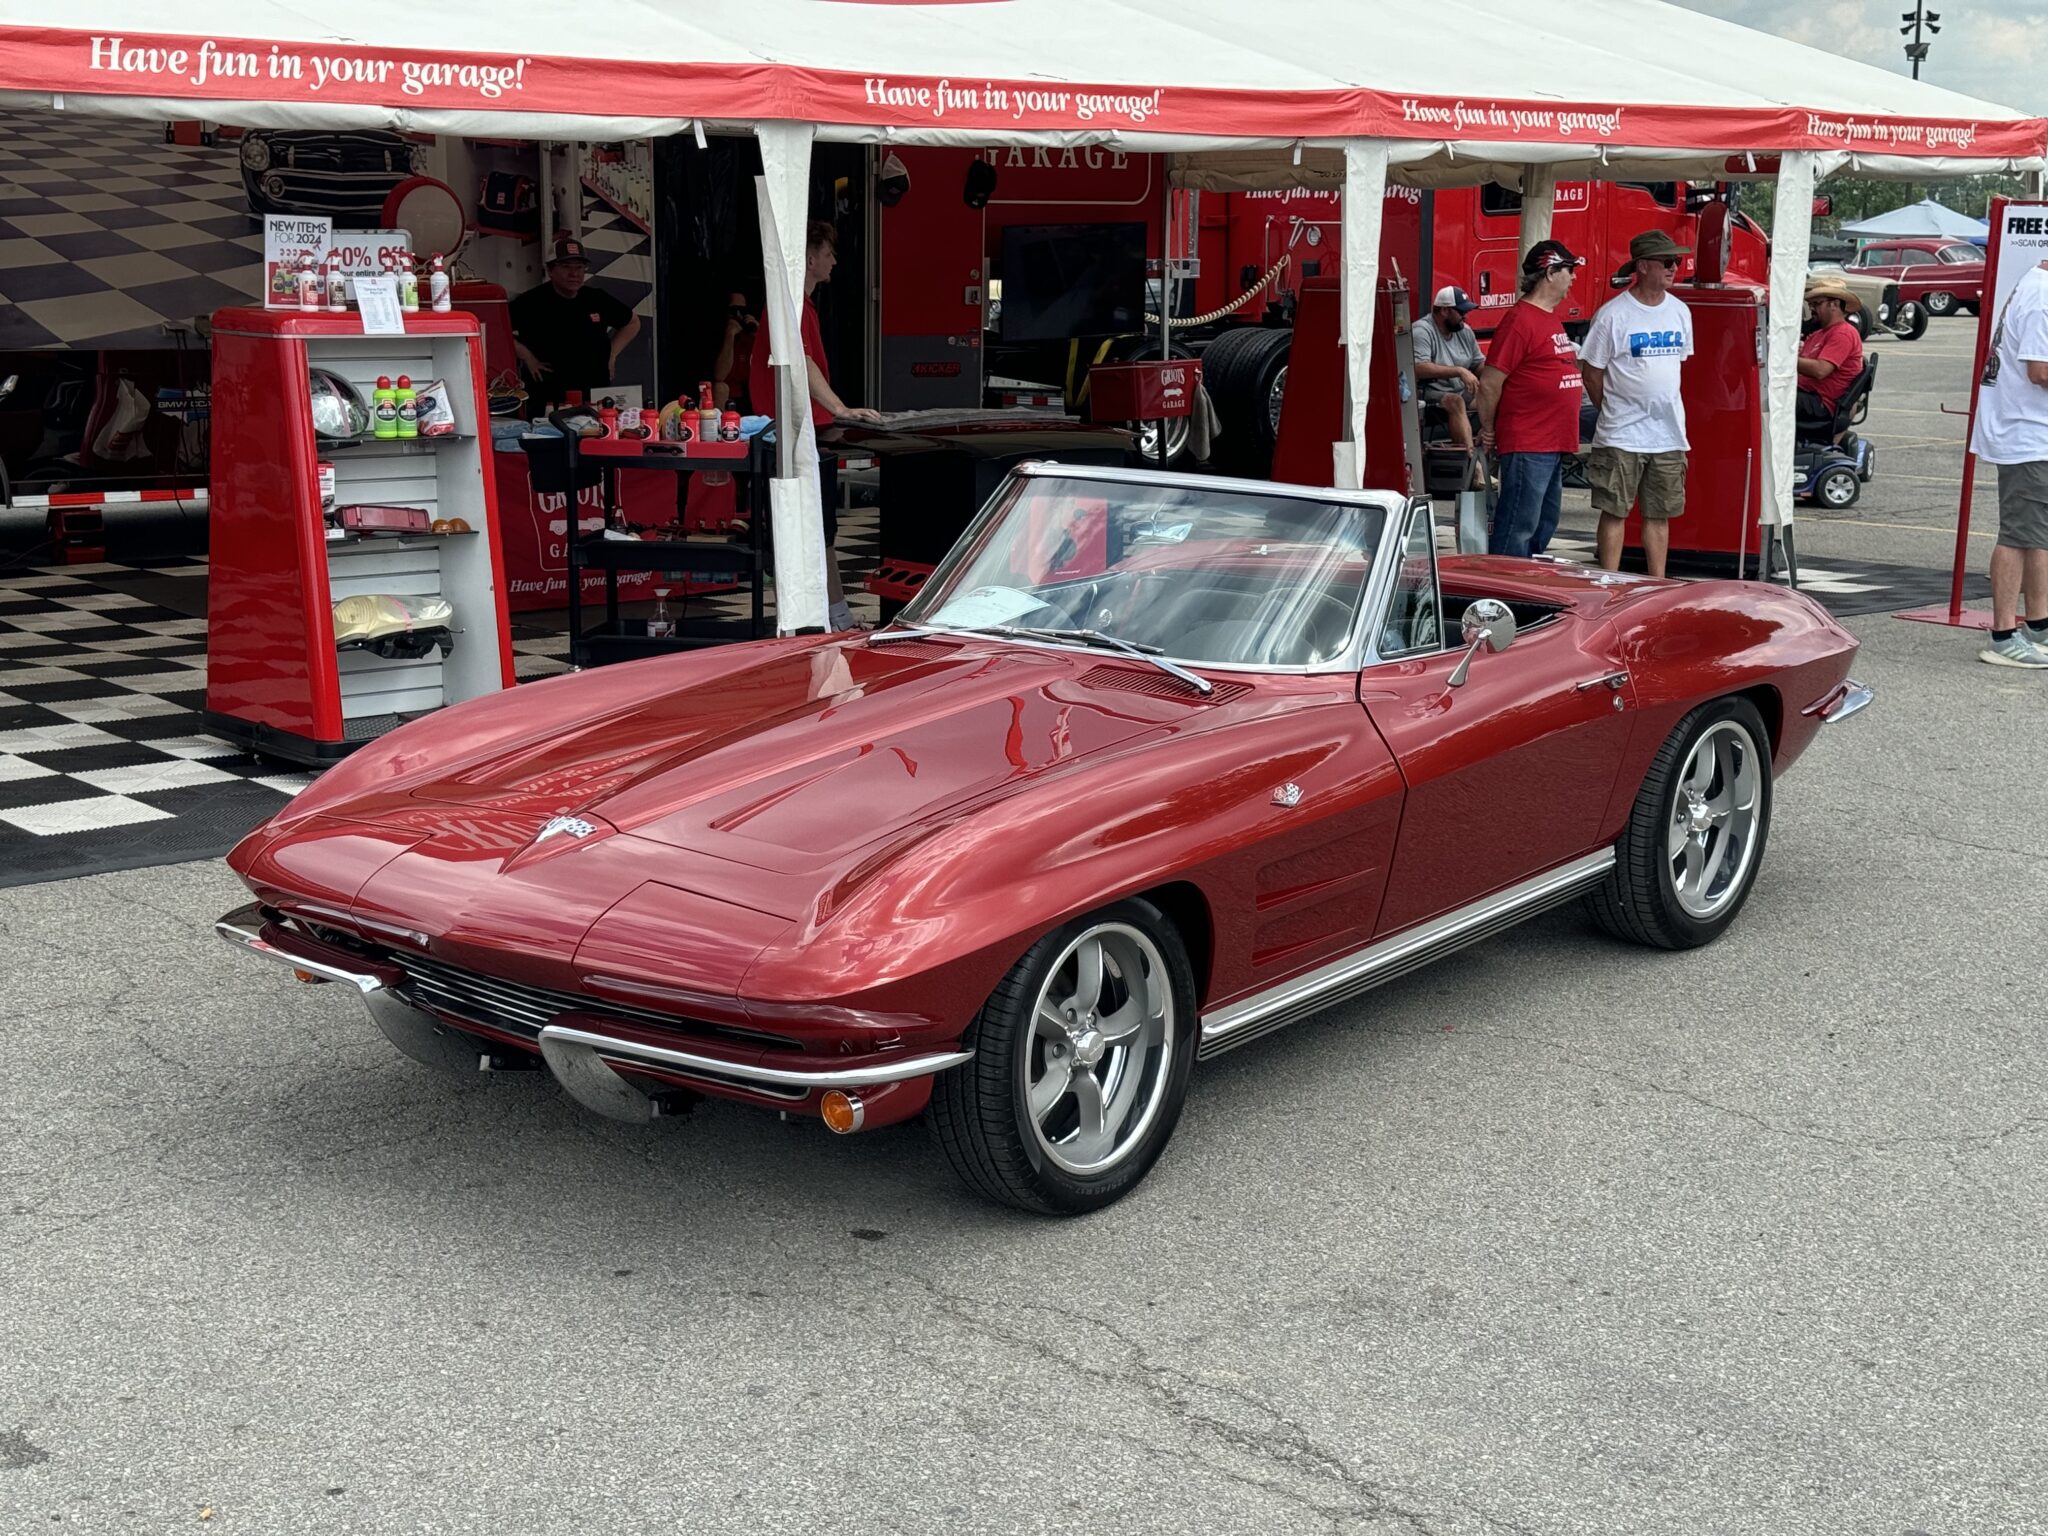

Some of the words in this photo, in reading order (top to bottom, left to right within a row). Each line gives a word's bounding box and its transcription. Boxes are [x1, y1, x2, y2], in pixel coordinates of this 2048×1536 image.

[89, 36, 188, 74] Have
[190, 40, 259, 86] fun
[266, 45, 303, 79] in
[309, 56, 394, 90] your
[864, 78, 930, 107] Have
[933, 80, 979, 117] fun
[983, 82, 1009, 110] in
[1012, 90, 1070, 119] your
[1401, 99, 1451, 123] Have
[1453, 100, 1487, 131] fun
[1488, 103, 1509, 127] in
[1510, 107, 1553, 133] your
[1806, 112, 1844, 137] Have
[1873, 119, 1888, 140] in
[1888, 124, 1923, 147] your
[1555, 187, 1584, 201] RAGE
[269, 220, 296, 231] NEW
[297, 222, 327, 234] ITEMS
[2007, 217, 2043, 235] FREE
[274, 232, 295, 243] FOR
[296, 233, 322, 244] 2024
[158, 400, 187, 409] BMW
[1162, 399, 1185, 409] GARAGE
[509, 580, 543, 593] Have
[543, 577, 567, 594] fun
[581, 575, 607, 591] you
